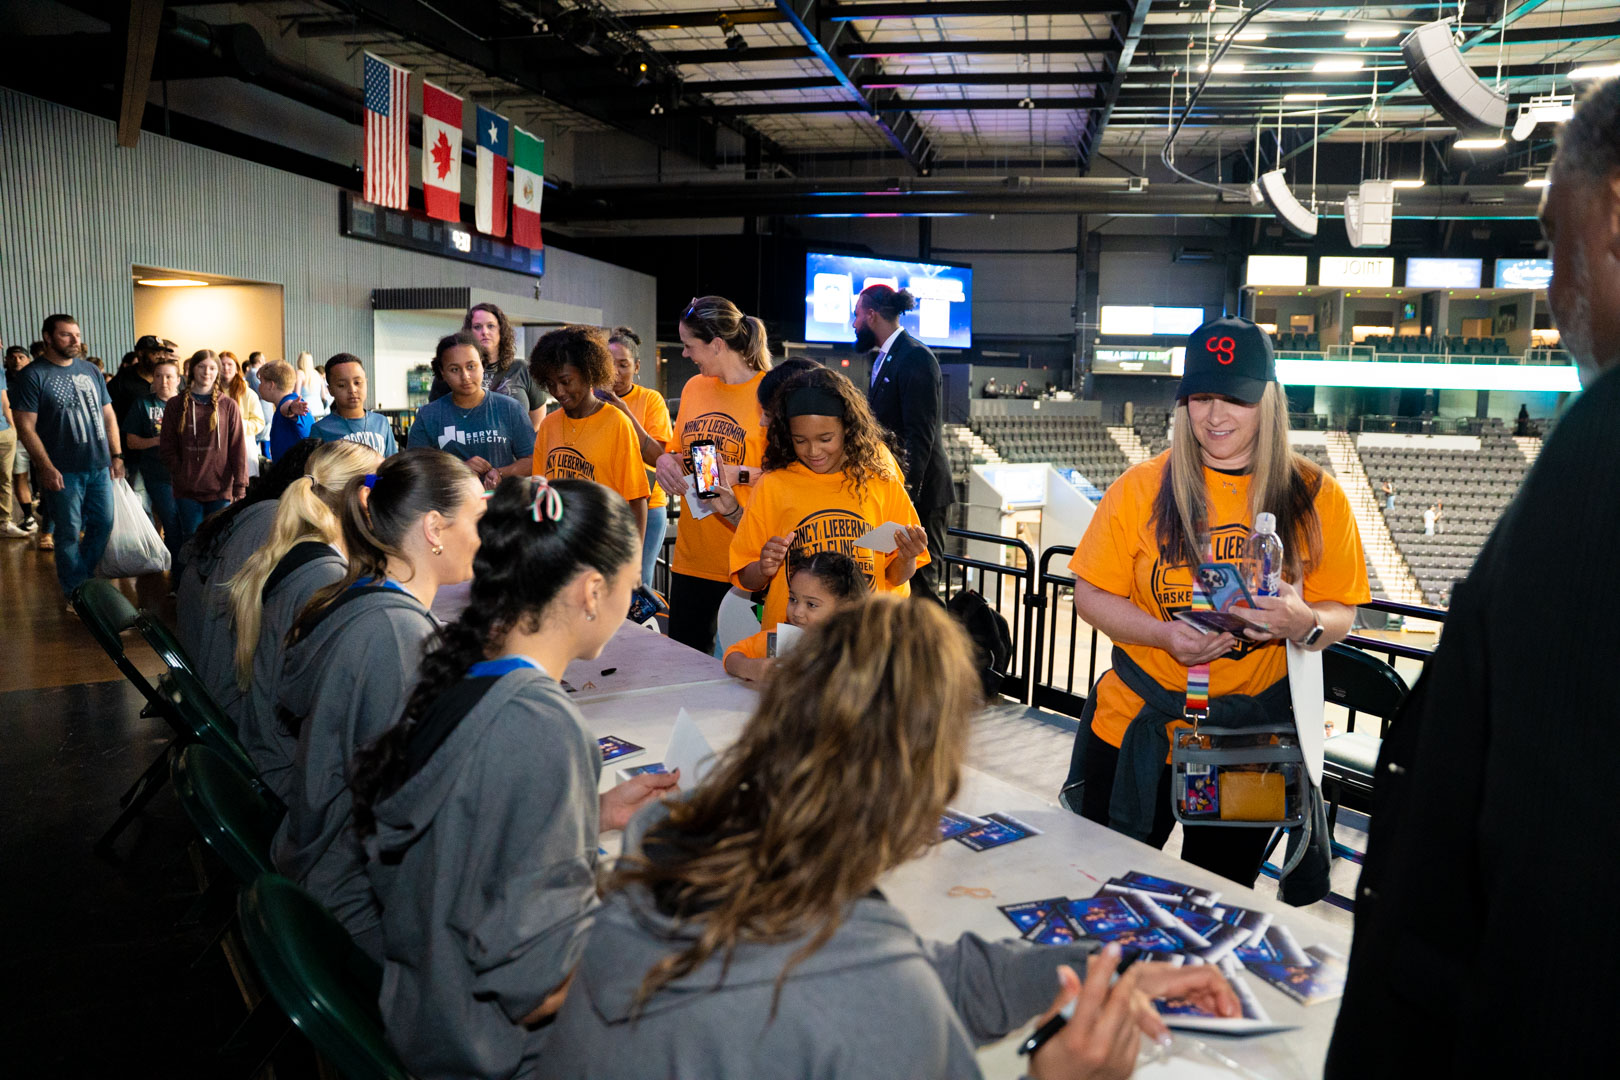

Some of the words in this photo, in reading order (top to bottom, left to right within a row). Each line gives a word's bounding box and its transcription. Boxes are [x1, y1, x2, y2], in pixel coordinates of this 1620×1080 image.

[466, 430, 498, 438] SERVE
[685, 418, 707, 433] NANCY
[708, 418, 747, 445] LIEBERMAN
[557, 453, 595, 480] LIEBERMAN
